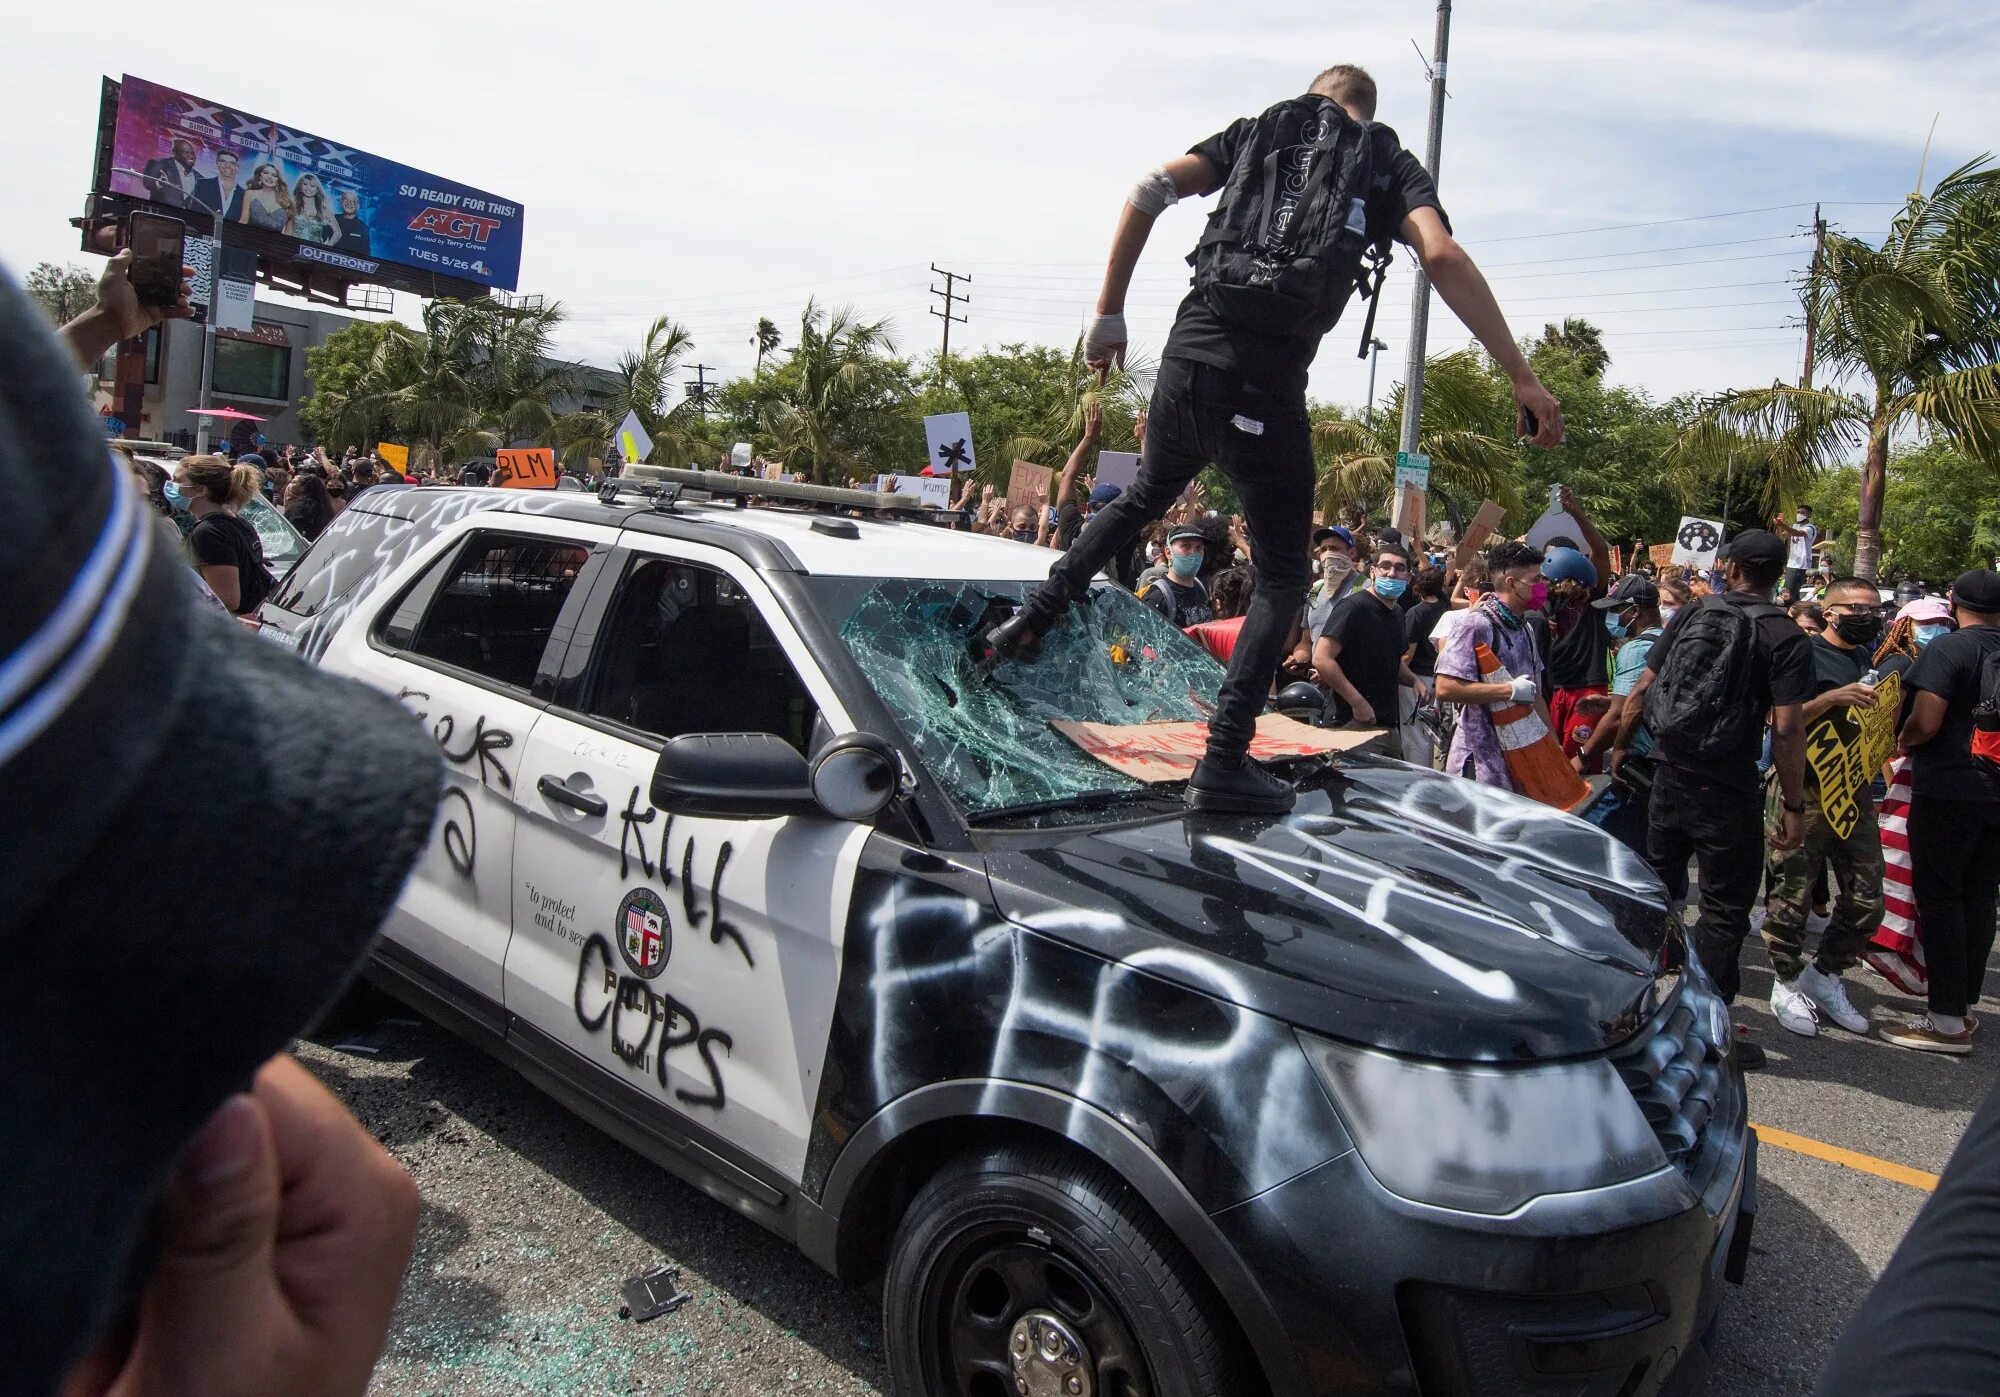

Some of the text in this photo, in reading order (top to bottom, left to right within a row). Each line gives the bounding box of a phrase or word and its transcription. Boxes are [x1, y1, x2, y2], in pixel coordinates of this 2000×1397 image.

[188, 121, 214, 136] SIMON
[239, 137, 260, 150] SOFIA
[285, 151, 303, 162] HEIDI
[325, 163, 347, 175] HOWIE
[399, 184, 516, 218] SO READY FOR THIS!
[407, 206, 501, 243] AGT
[415, 234, 437, 243] Hosted
[446, 239, 464, 249] Terry
[465, 242, 487, 251] Crews
[302, 248, 376, 273] OUTFRONT
[408, 246, 439, 263] TUES
[441, 256, 469, 270] 5/26
[498, 453, 548, 480] BLM
[1408, 457, 1428, 467] PARKING
[921, 477, 949, 498] Trump
[1016, 465, 1049, 488] FUCK
[1847, 735, 1865, 789] LIVES
[1807, 722, 1859, 838] MATTER
[620, 785, 753, 968] KILL
[541, 893, 577, 922] protect
[535, 911, 588, 948] and to ser
[575, 933, 733, 1109] COPS
